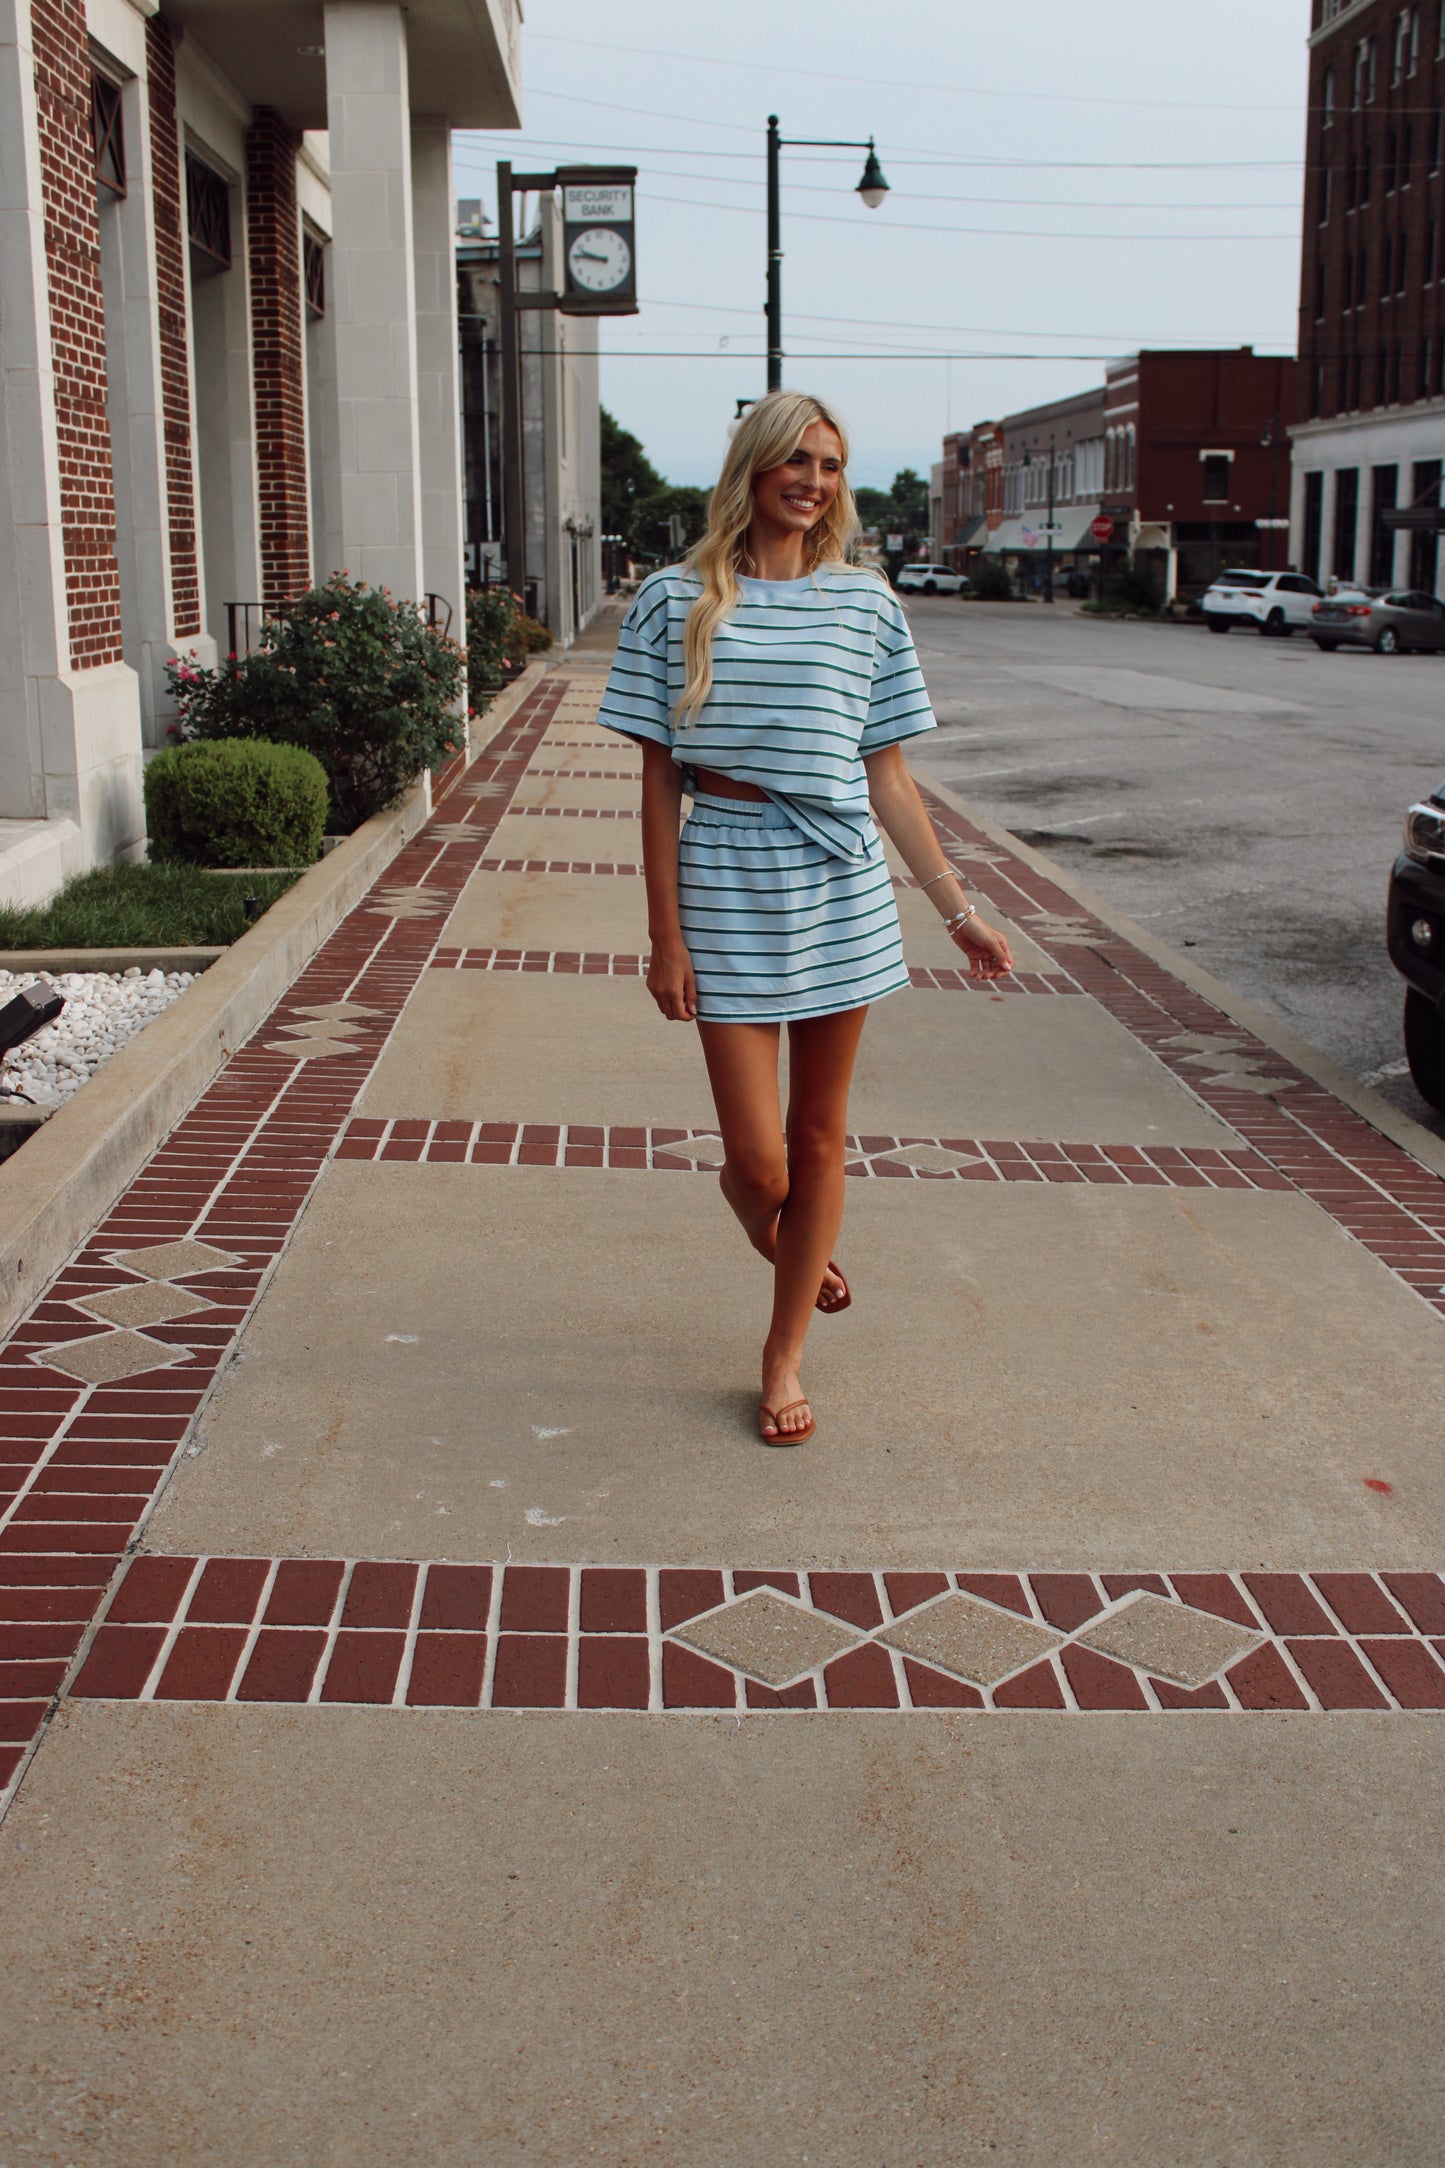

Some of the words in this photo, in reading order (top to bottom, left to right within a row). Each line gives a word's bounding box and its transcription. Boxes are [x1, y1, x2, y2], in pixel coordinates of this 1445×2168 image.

[568, 189, 628, 202] SECURITY
[581, 204, 615, 216] BANK
[1091, 522, 1112, 532] STOP
